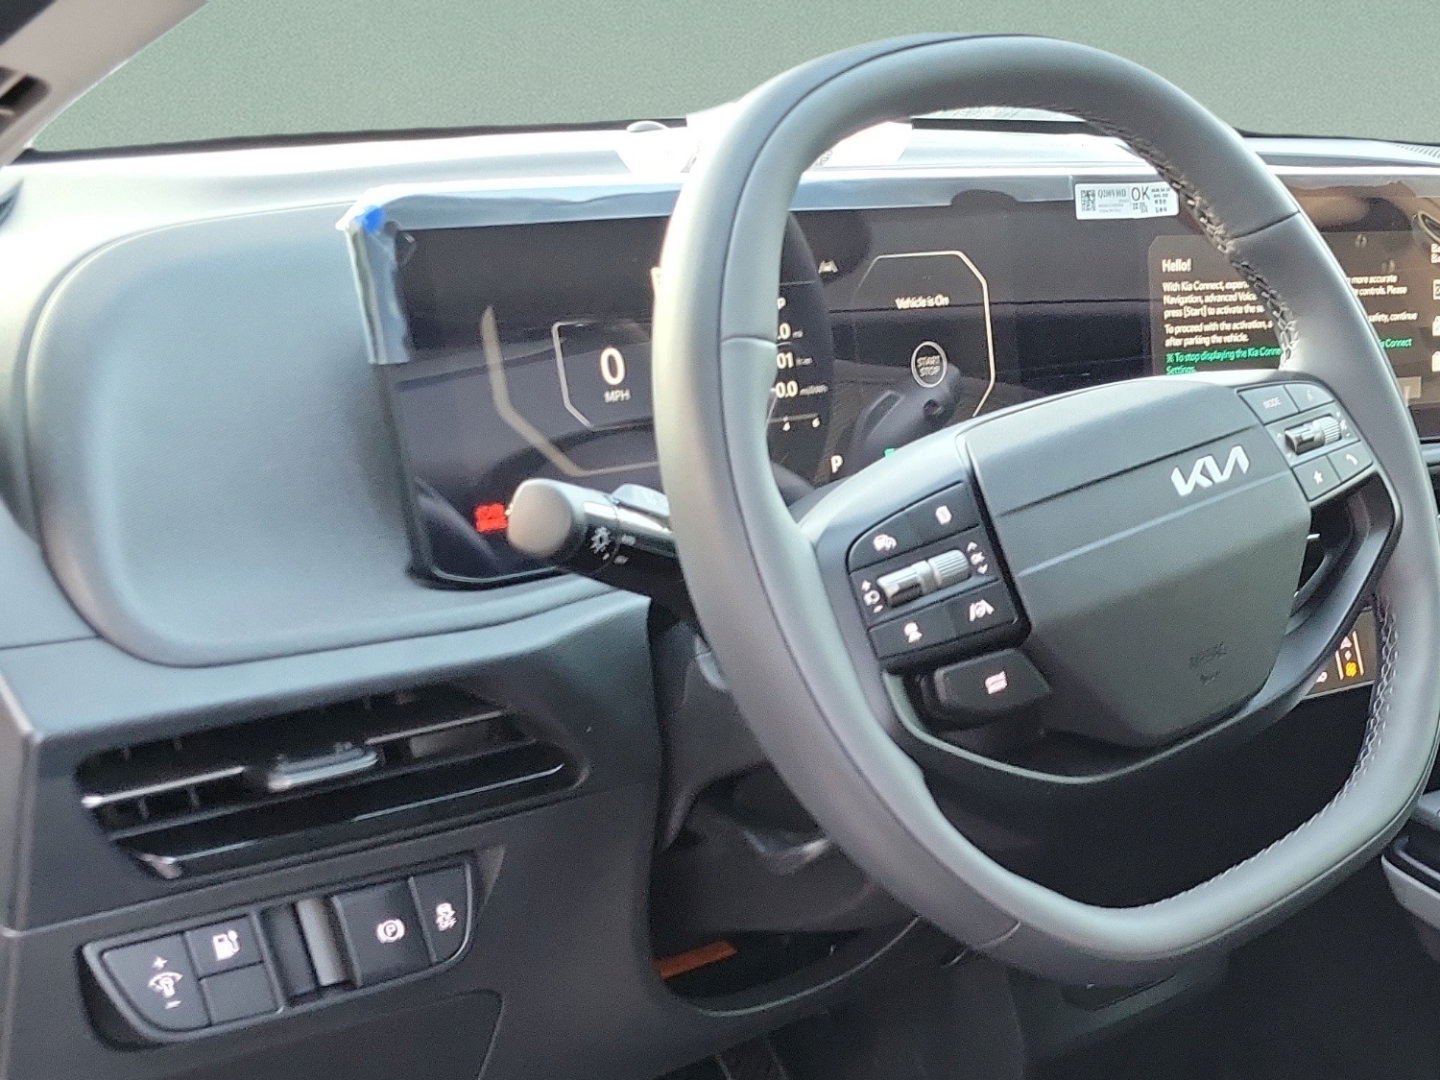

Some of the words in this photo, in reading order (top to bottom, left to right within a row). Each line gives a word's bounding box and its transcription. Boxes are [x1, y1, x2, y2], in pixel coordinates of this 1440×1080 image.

[1131, 186, 1150, 201] OK
[1162, 258, 1191, 273] Hello!
[1162, 281, 1180, 292] With
[1181, 281, 1193, 291] Kia
[1193, 280, 1224, 292] Connect,
[1369, 275, 1398, 284] accurate
[1387, 285, 1407, 295] Please
[934, 294, 950, 307] On
[1163, 295, 1204, 306] Navigation,
[1204, 292, 1237, 304] advanced
[1164, 308, 1183, 320] press
[1207, 306, 1215, 316] to
[1216, 306, 1243, 316] activate
[1244, 304, 1255, 314] the
[1164, 323, 1174, 334] To
[1175, 323, 1203, 336] proceed
[1204, 321, 1218, 332] with
[1219, 320, 1231, 331] the
[1165, 336, 1183, 348] after
[1184, 335, 1210, 348] parking
[1211, 333, 1222, 345] the
[1385, 338, 1412, 348] Connect
[600, 347, 626, 386] 0
[604, 389, 630, 403] MPH
[831, 454, 843, 475] P
[1171, 445, 1250, 496] KIA
